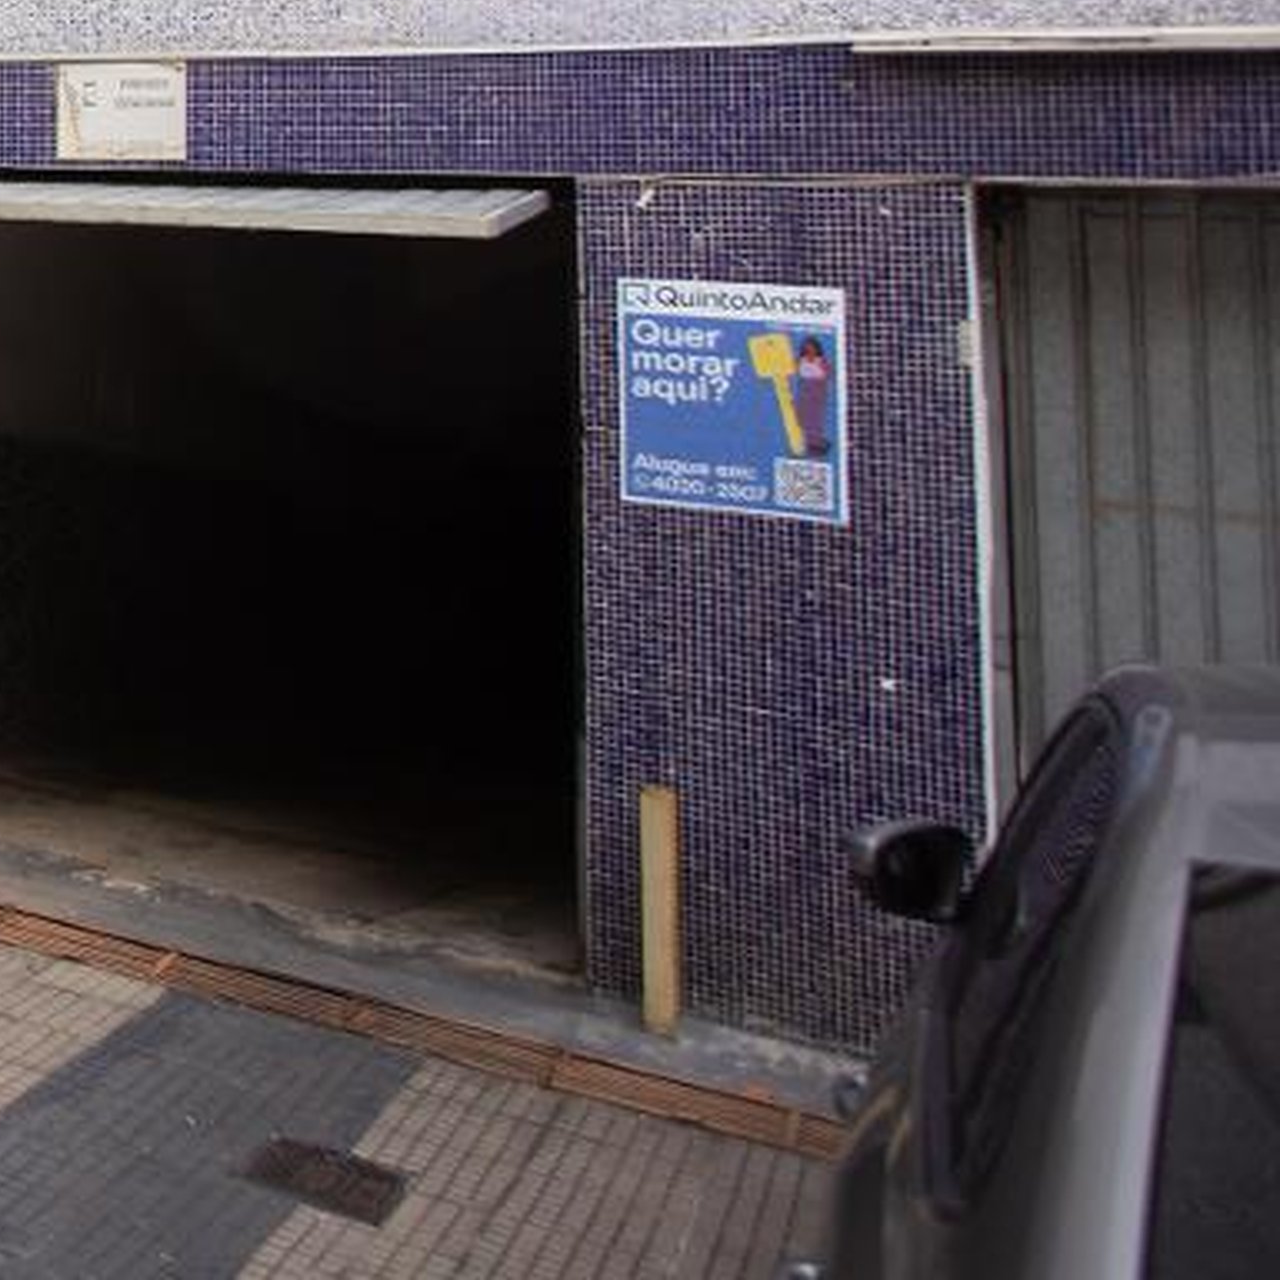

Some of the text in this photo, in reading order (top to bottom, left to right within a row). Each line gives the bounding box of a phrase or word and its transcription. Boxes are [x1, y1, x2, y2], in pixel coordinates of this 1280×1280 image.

[656, 286, 836, 314] QuintoAndar
[632, 320, 721, 348] Quer
[632, 350, 738, 377] morar
[632, 377, 730, 406] aqui?
